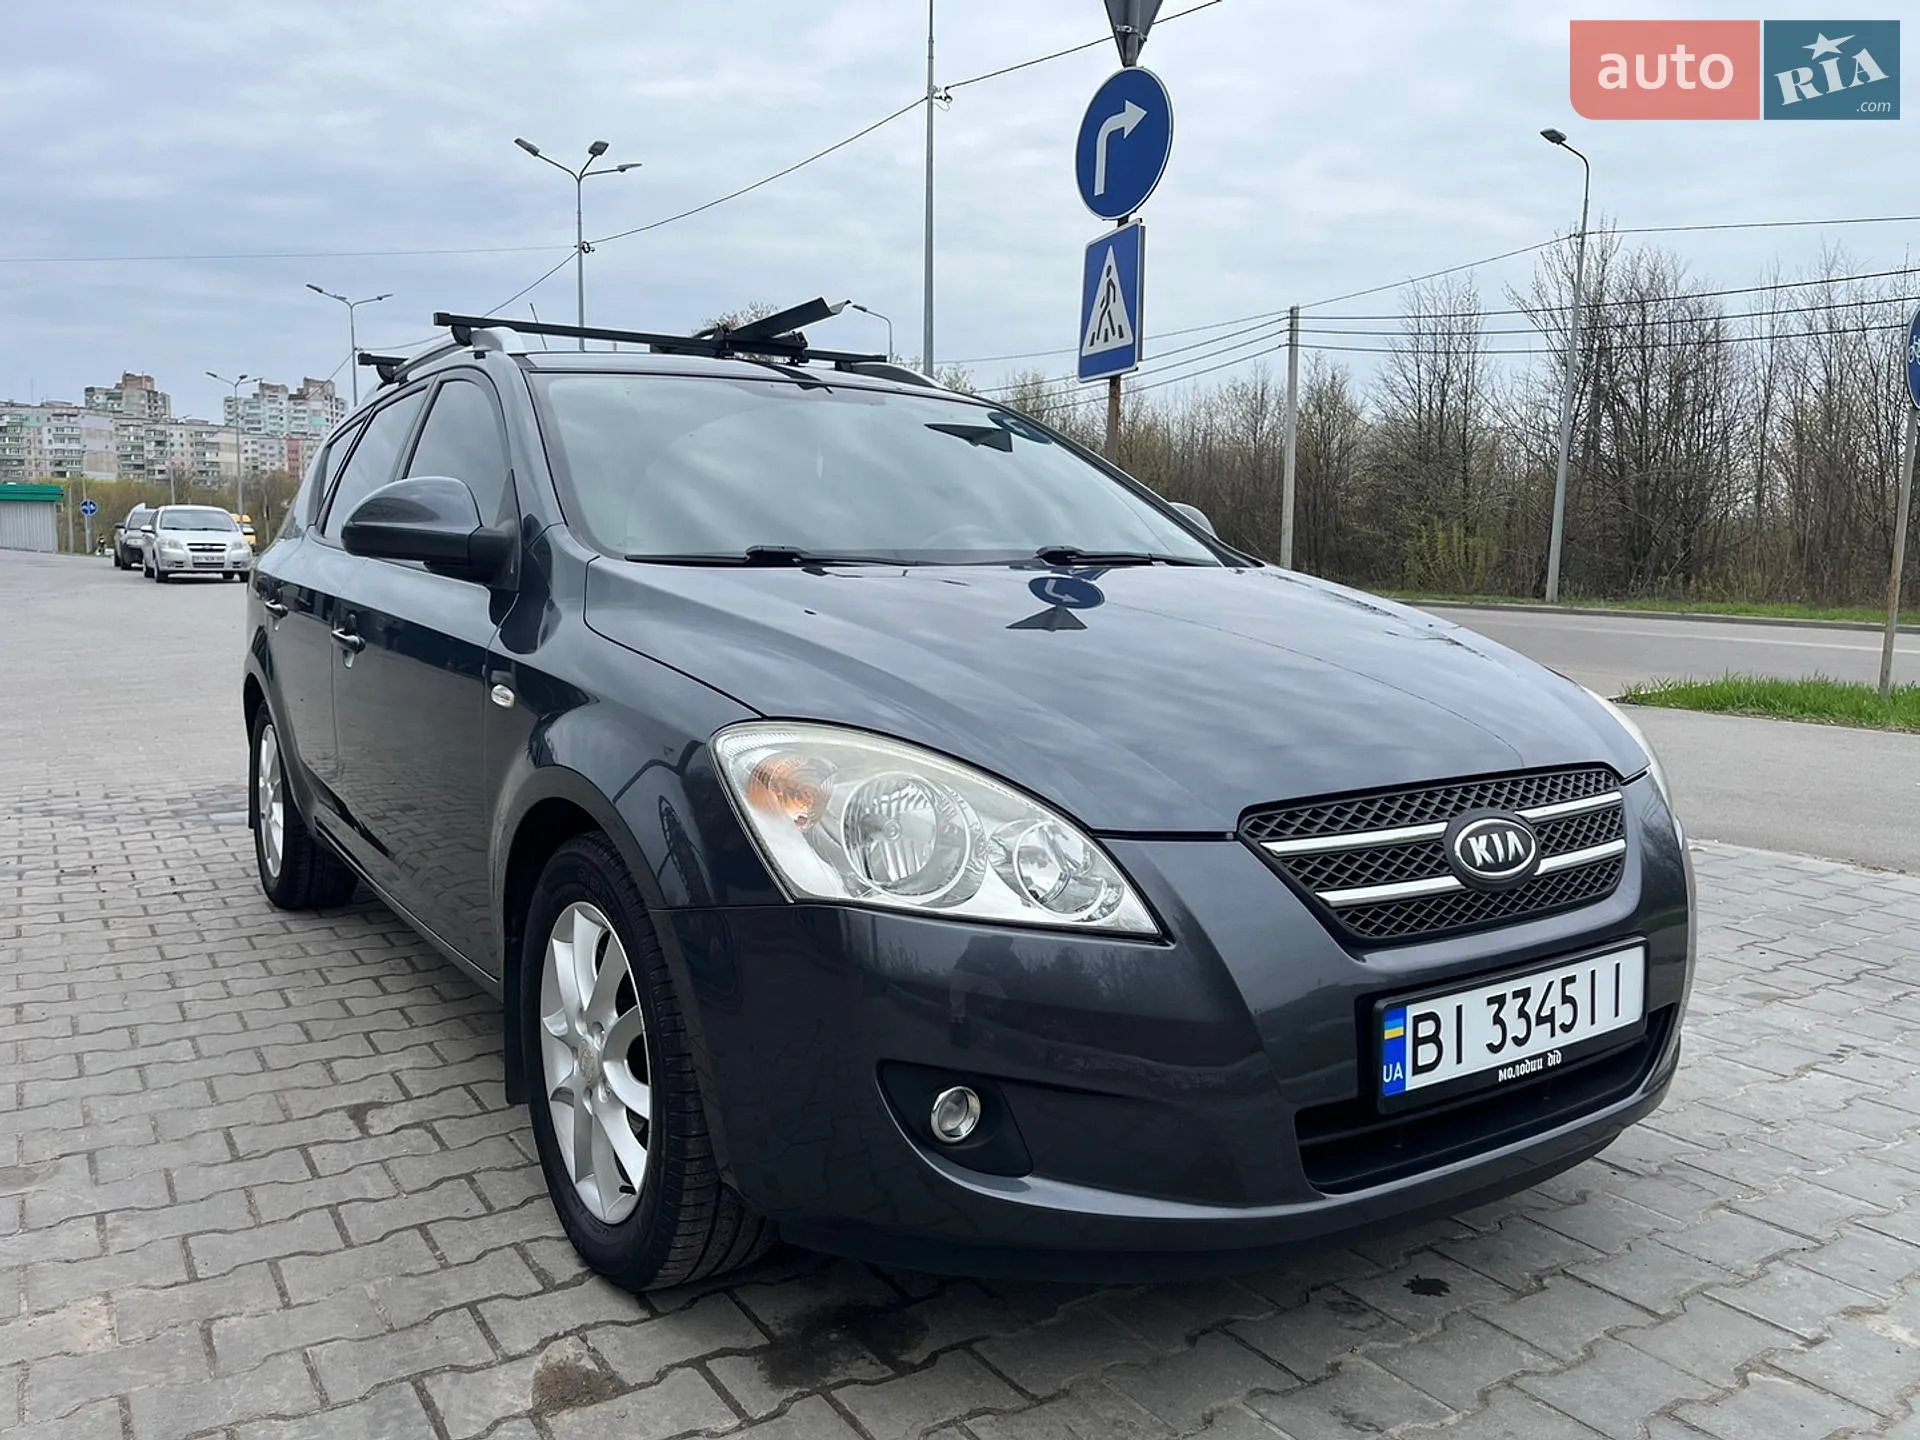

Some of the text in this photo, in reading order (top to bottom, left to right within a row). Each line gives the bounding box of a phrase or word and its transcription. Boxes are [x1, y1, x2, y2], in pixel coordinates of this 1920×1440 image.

[1467, 830, 1526, 867] KIA
[1411, 1003, 1463, 1076] BI
[1485, 974, 1579, 1055] 3345
[1383, 1064, 1403, 1083] UA
